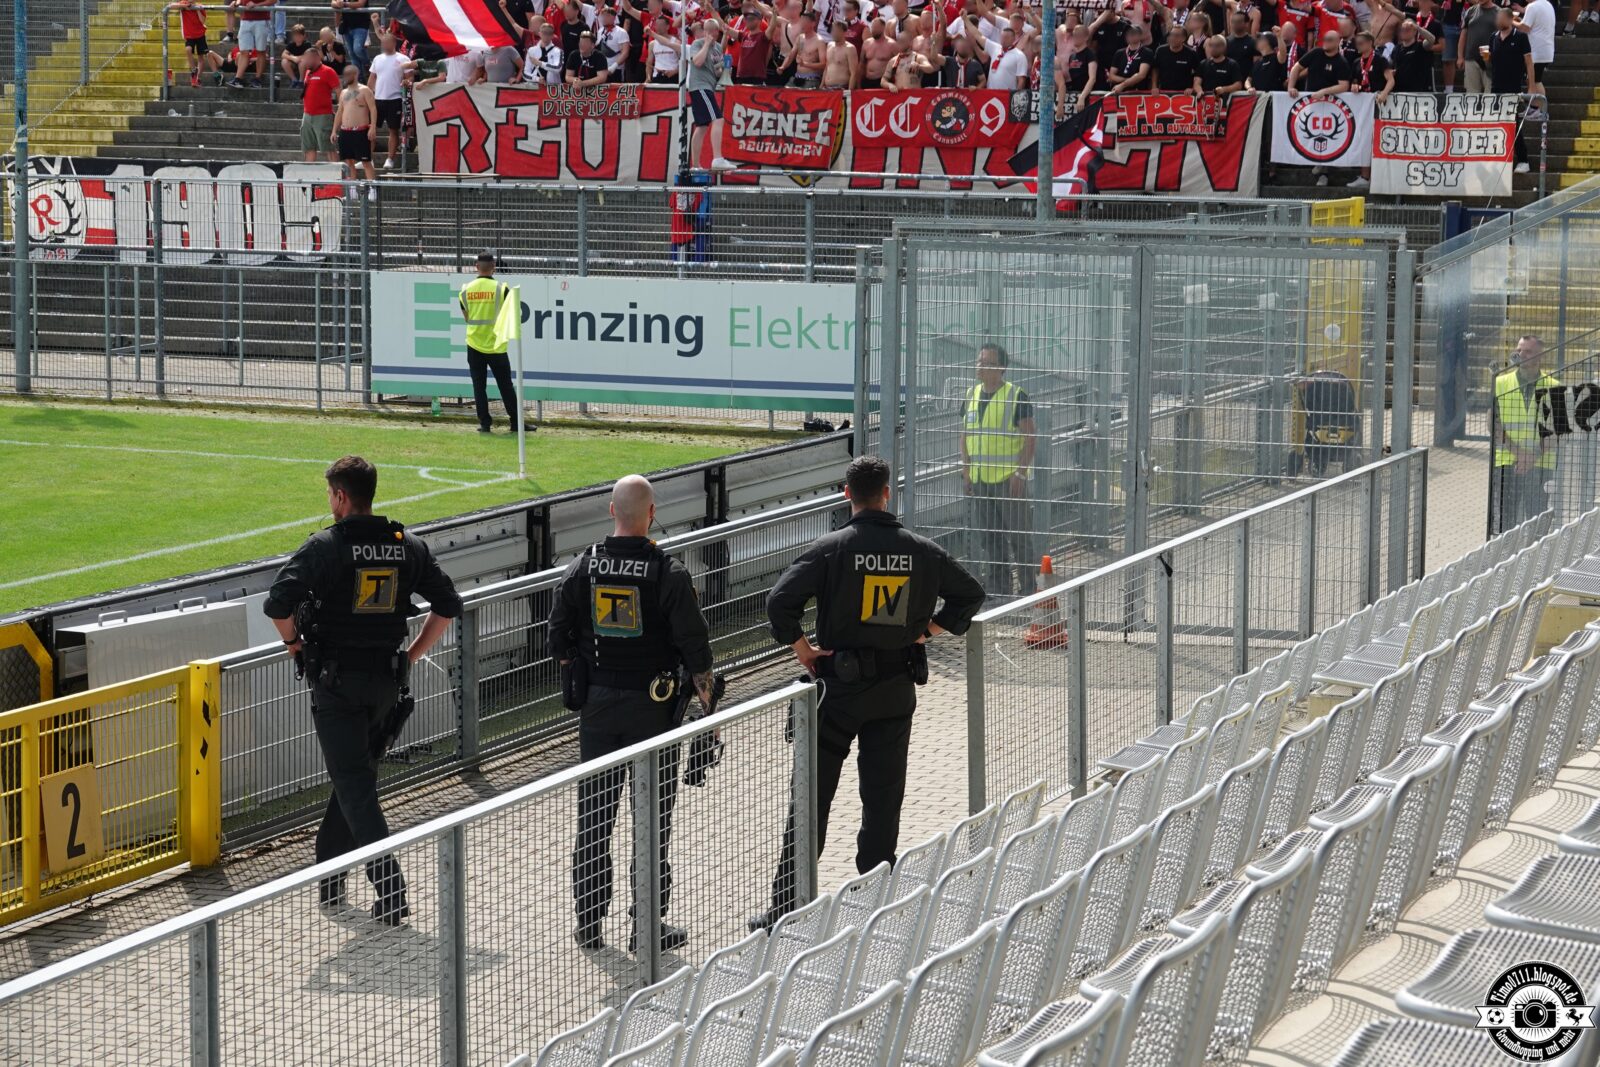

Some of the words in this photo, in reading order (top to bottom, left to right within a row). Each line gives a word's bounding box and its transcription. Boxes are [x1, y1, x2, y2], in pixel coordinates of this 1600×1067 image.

[617, 83, 637, 99] AI
[1377, 94, 1437, 122] WIR
[1441, 94, 1518, 122] ALLE
[730, 102, 811, 141] SZENE
[738, 139, 823, 157] REUTLINGEN
[1381, 127, 1447, 156] SIND
[1449, 129, 1507, 156] DER
[1406, 161, 1465, 187] SSV
[467, 291, 495, 300] SECURITY
[352, 545, 406, 561] POLIZEI
[854, 554, 913, 572] POLIZEI
[587, 558, 649, 578] POLIZEI
[61, 782, 86, 860] 2
